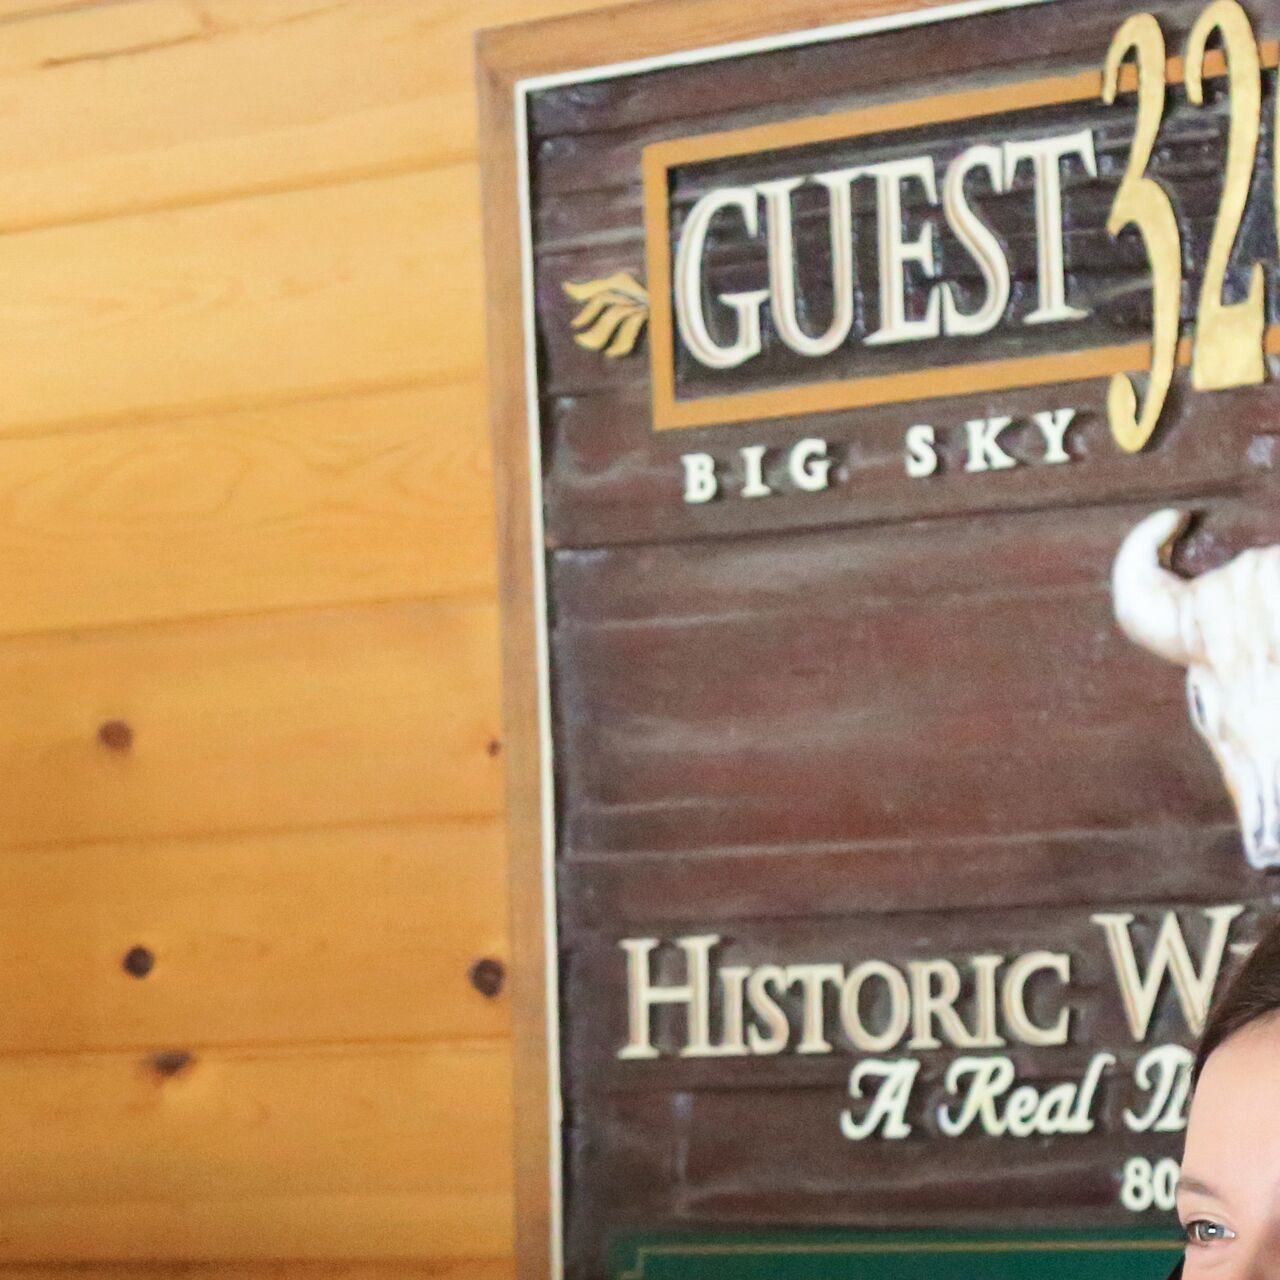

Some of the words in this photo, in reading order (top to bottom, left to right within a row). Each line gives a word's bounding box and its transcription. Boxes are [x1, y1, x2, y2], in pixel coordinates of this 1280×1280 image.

[674, 129, 1098, 369] GUEST
[682, 437, 831, 504] BIG
[905, 408, 1078, 478] SKY
[840, 1058, 919, 1140] A
[937, 1053, 1115, 1137] Real
